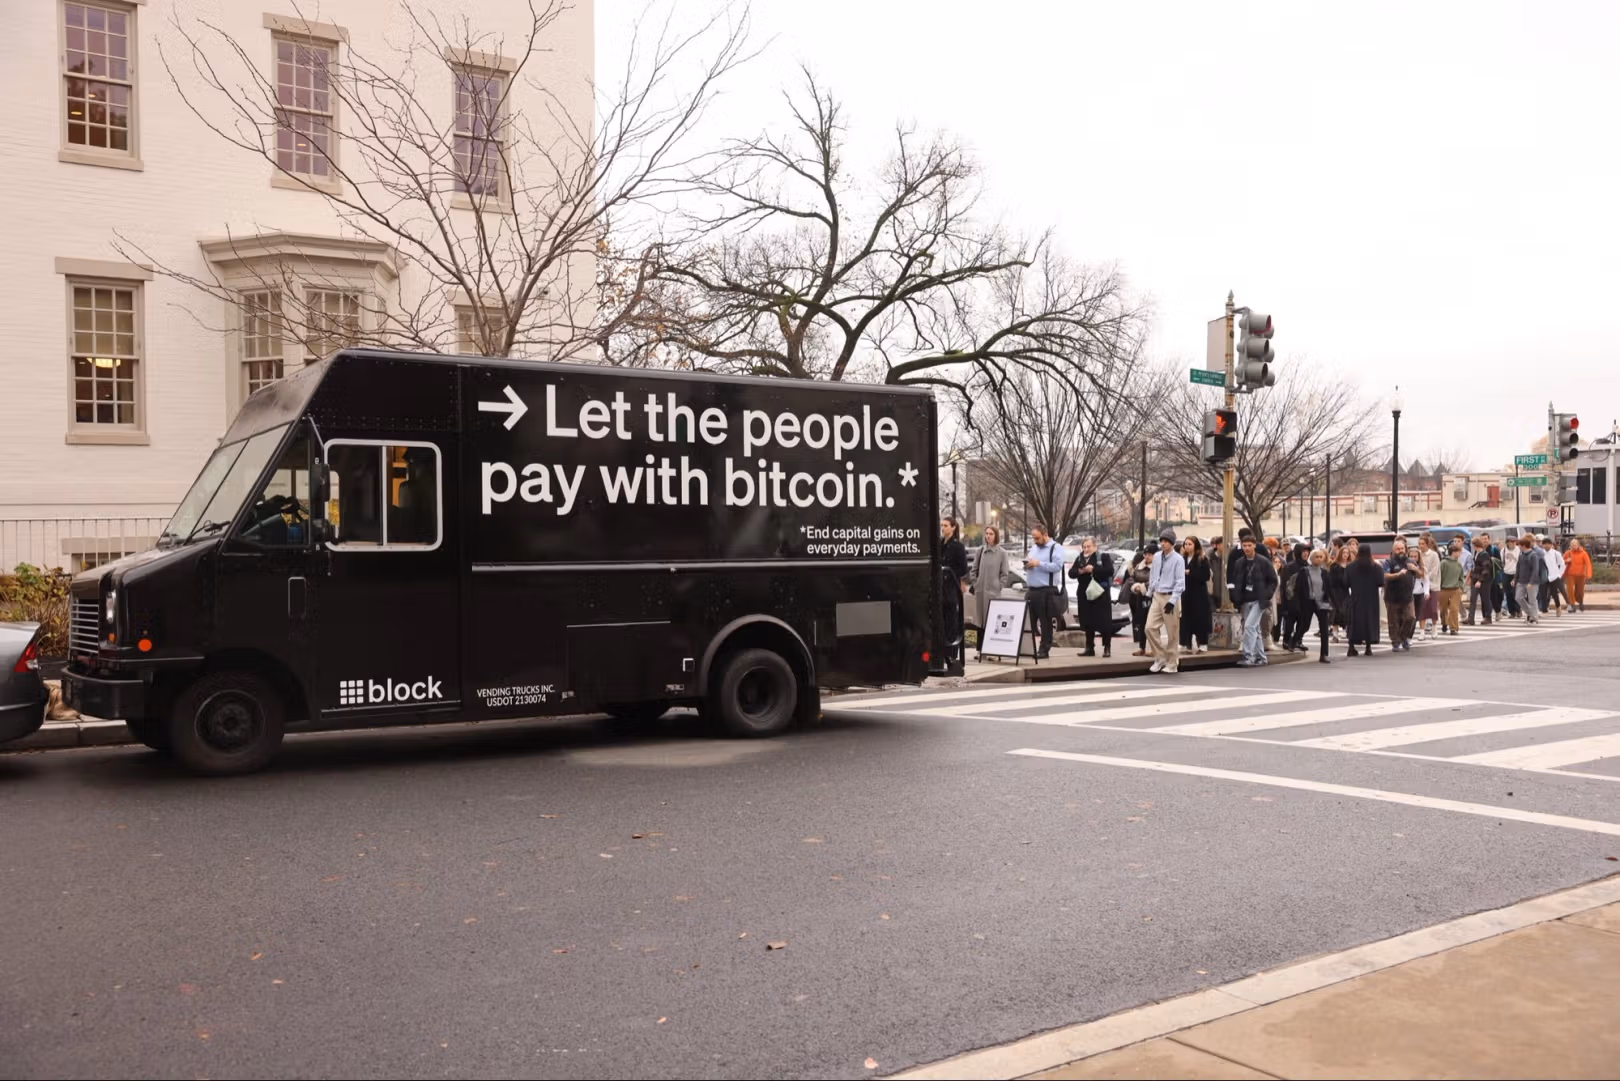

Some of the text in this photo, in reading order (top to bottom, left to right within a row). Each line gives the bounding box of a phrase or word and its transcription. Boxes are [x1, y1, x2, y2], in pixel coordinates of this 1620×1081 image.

[546, 384, 899, 460] Let the people
[1516, 456, 1539, 464] FIRST
[481, 461, 587, 516] pay
[599, 454, 709, 505] with
[831, 525, 872, 542] capital
[873, 525, 905, 542] gains
[905, 528, 921, 539] on
[806, 541, 921, 557] everyday payments.
[368, 676, 443, 703] block
[476, 684, 556, 698] VENDING TRUCKS INC.
[486, 694, 547, 707] USDOT 2130074
